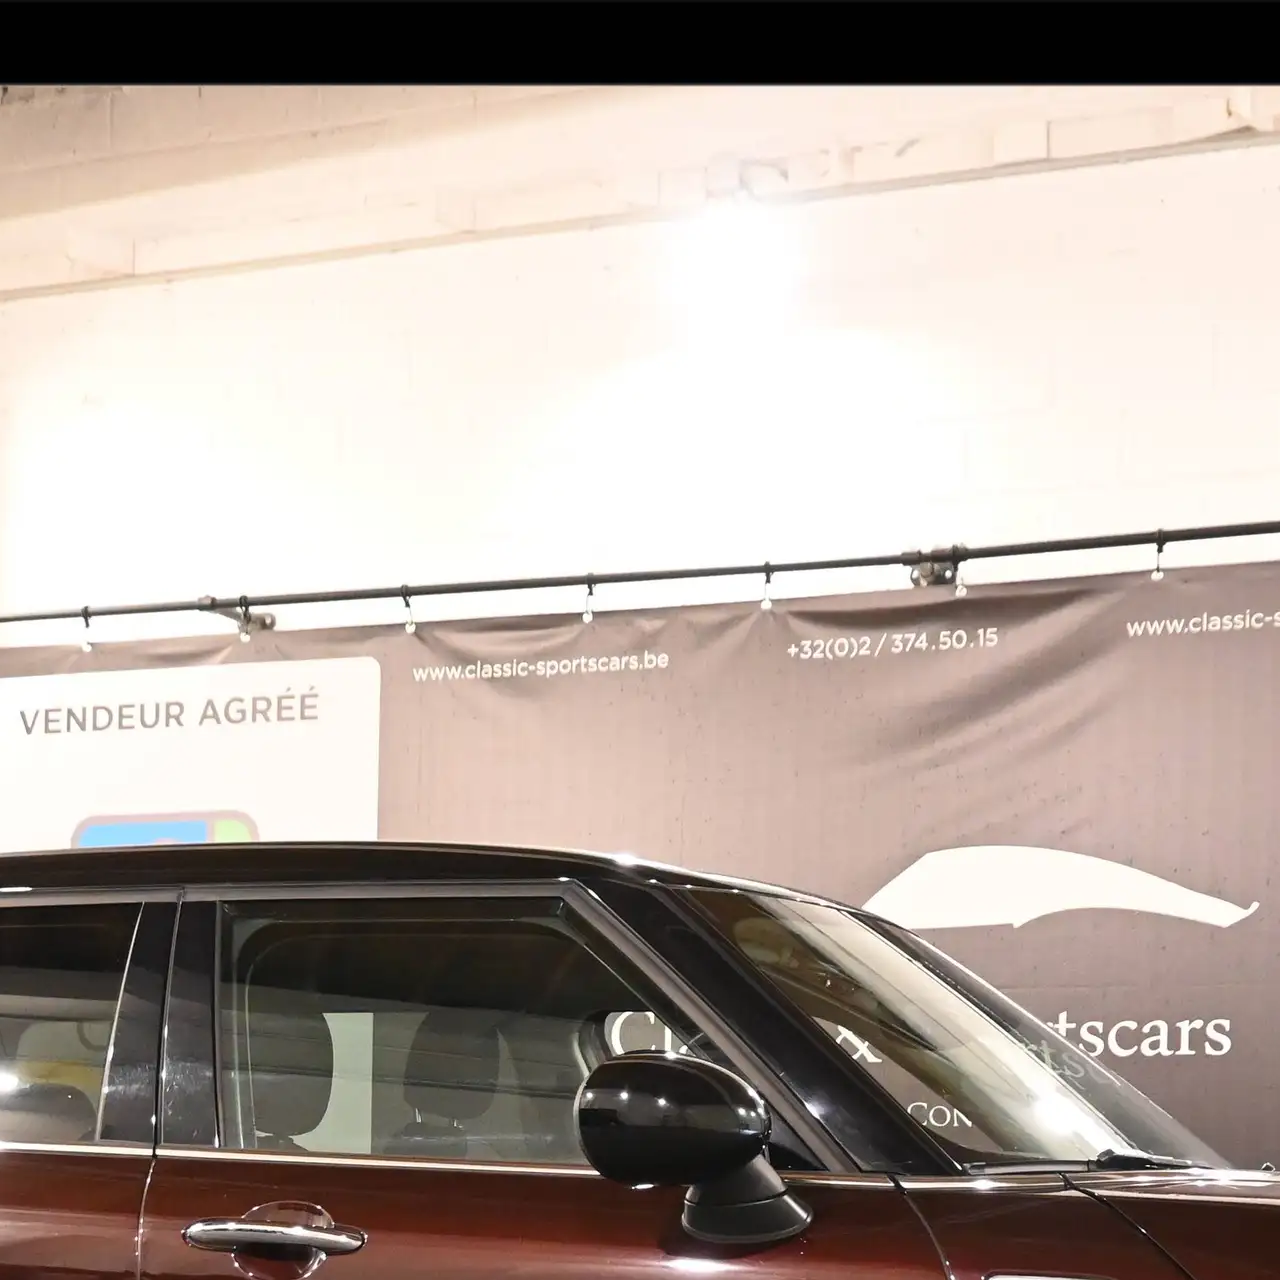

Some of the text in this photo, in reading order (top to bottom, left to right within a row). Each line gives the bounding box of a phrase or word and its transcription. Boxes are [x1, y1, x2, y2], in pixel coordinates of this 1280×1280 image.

[412, 650, 669, 682] www.classic-sportscars.be
[19, 685, 320, 736] VENDEUR AGRÉÉ
[1047, 1010, 1232, 1057] tscars
